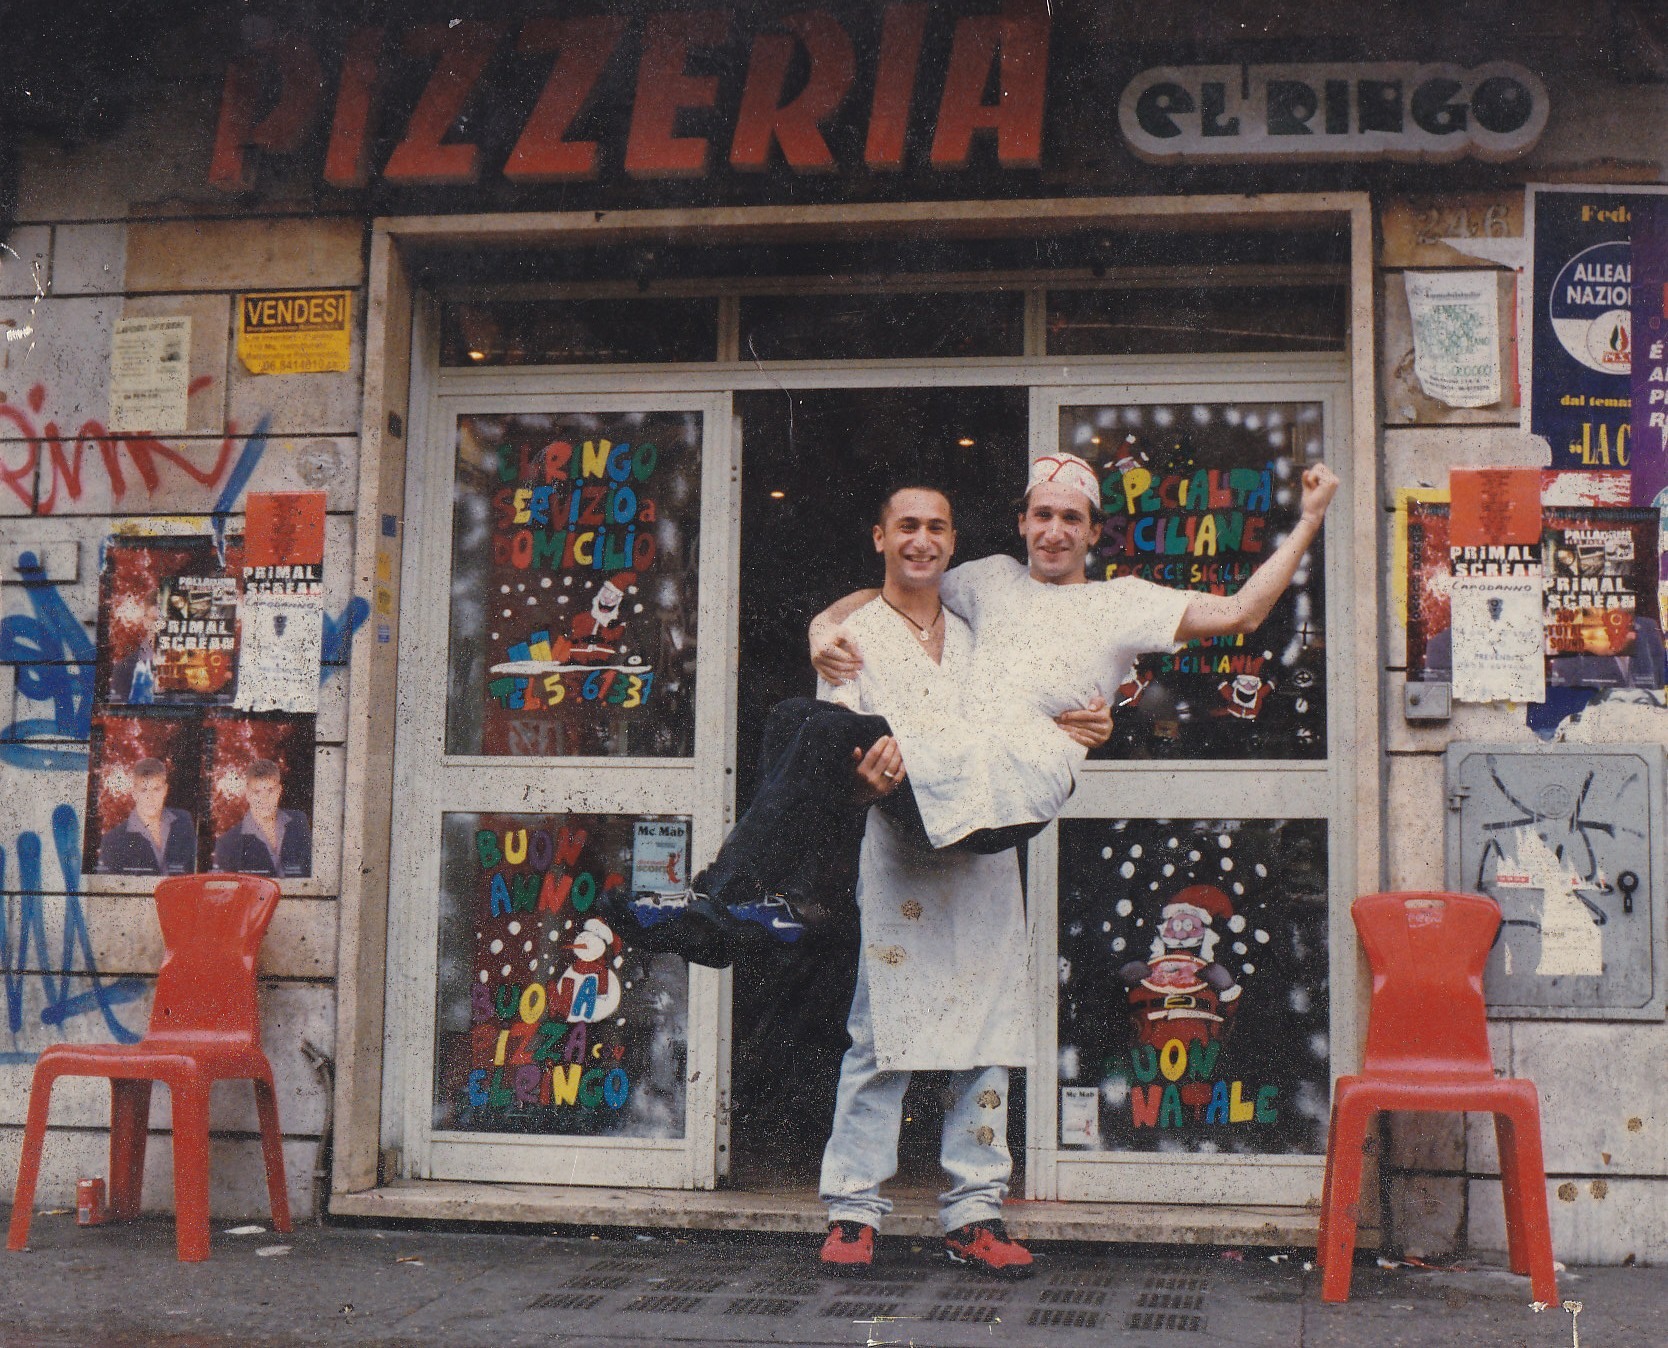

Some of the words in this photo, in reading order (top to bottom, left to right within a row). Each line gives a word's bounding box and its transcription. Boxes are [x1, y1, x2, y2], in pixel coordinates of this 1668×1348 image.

[206, 3, 1052, 190] PIZZERIA
[247, 298, 344, 325] VENDESI
[1566, 285, 1631, 306] NAZIO
[1648, 366, 1668, 382] A
[1649, 389, 1668, 405] P
[1100, 511, 1266, 557] SICILIANE
[1105, 562, 1185, 581] FOCACCE
[476, 826, 588, 870] BUON
[490, 871, 596, 918] ANNO
[471, 975, 599, 1025] BUONA
[1130, 1080, 1279, 1129] NATALE
